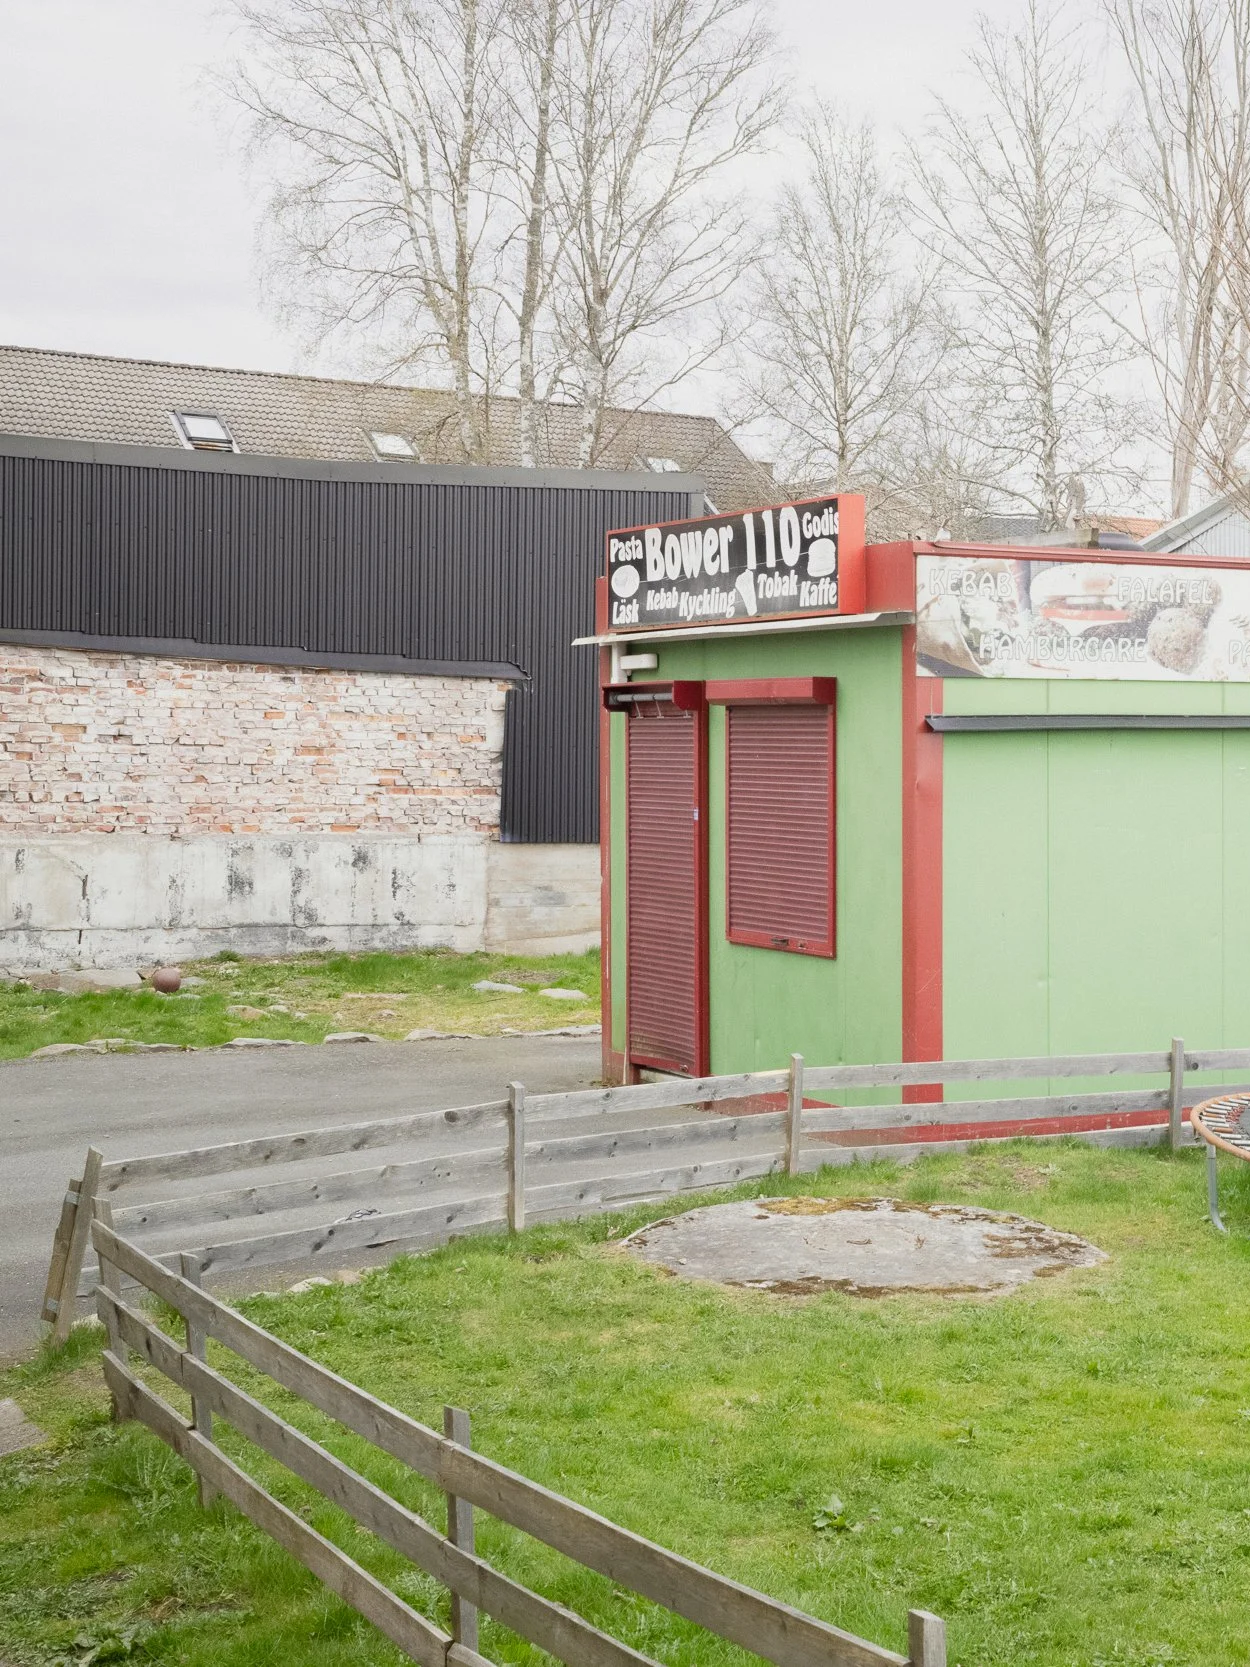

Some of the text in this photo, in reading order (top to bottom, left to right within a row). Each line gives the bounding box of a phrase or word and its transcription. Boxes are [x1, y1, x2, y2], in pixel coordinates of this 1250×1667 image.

[802, 507, 839, 539] Godis
[610, 535, 643, 563] Pasta
[644, 506, 801, 582] Bower 110
[646, 586, 679, 612] Kebab
[757, 569, 799, 600] Tobak
[799, 577, 838, 607] Kaffe
[928, 568, 1014, 601] KEBAB
[1117, 576, 1214, 605] FALAFEL
[612, 599, 640, 625] Läsk
[678, 587, 737, 622] Kyckling
[979, 633, 1148, 663] HAMBURGARE
